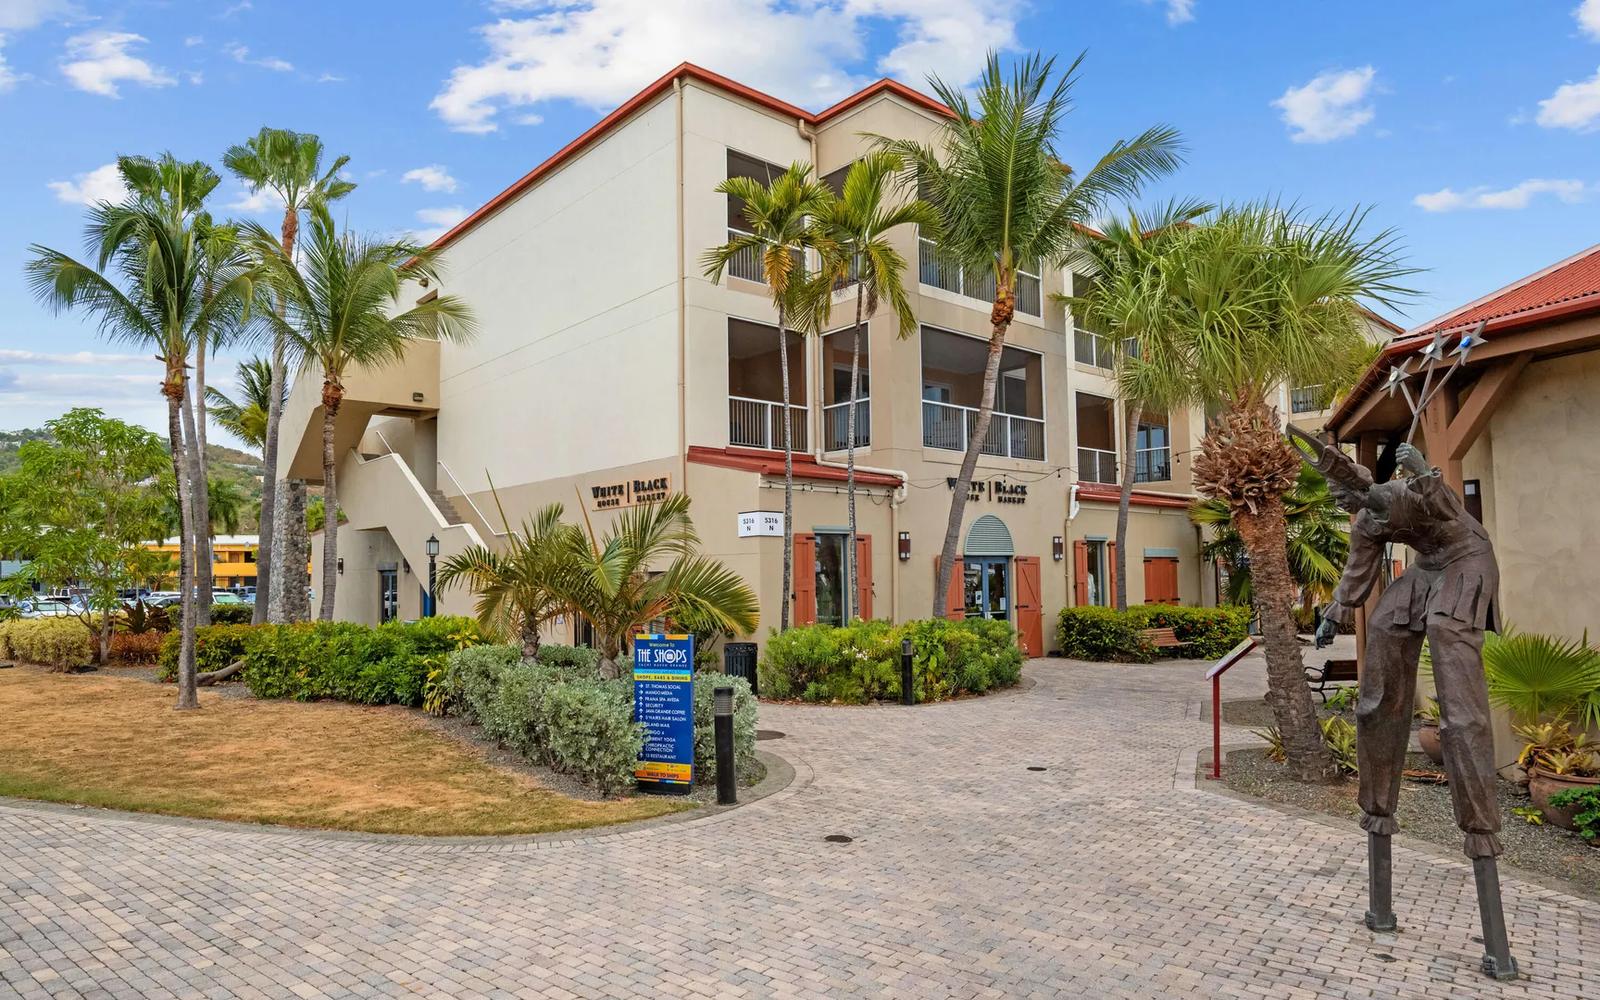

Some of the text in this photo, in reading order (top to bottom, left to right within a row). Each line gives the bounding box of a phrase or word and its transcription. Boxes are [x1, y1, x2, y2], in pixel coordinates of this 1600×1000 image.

[592, 477, 668, 498] WHITE BLACK
[947, 477, 1027, 495] WTE BLACK
[597, 499, 620, 508] HOUSE
[637, 649, 687, 663] THE SHOPS
